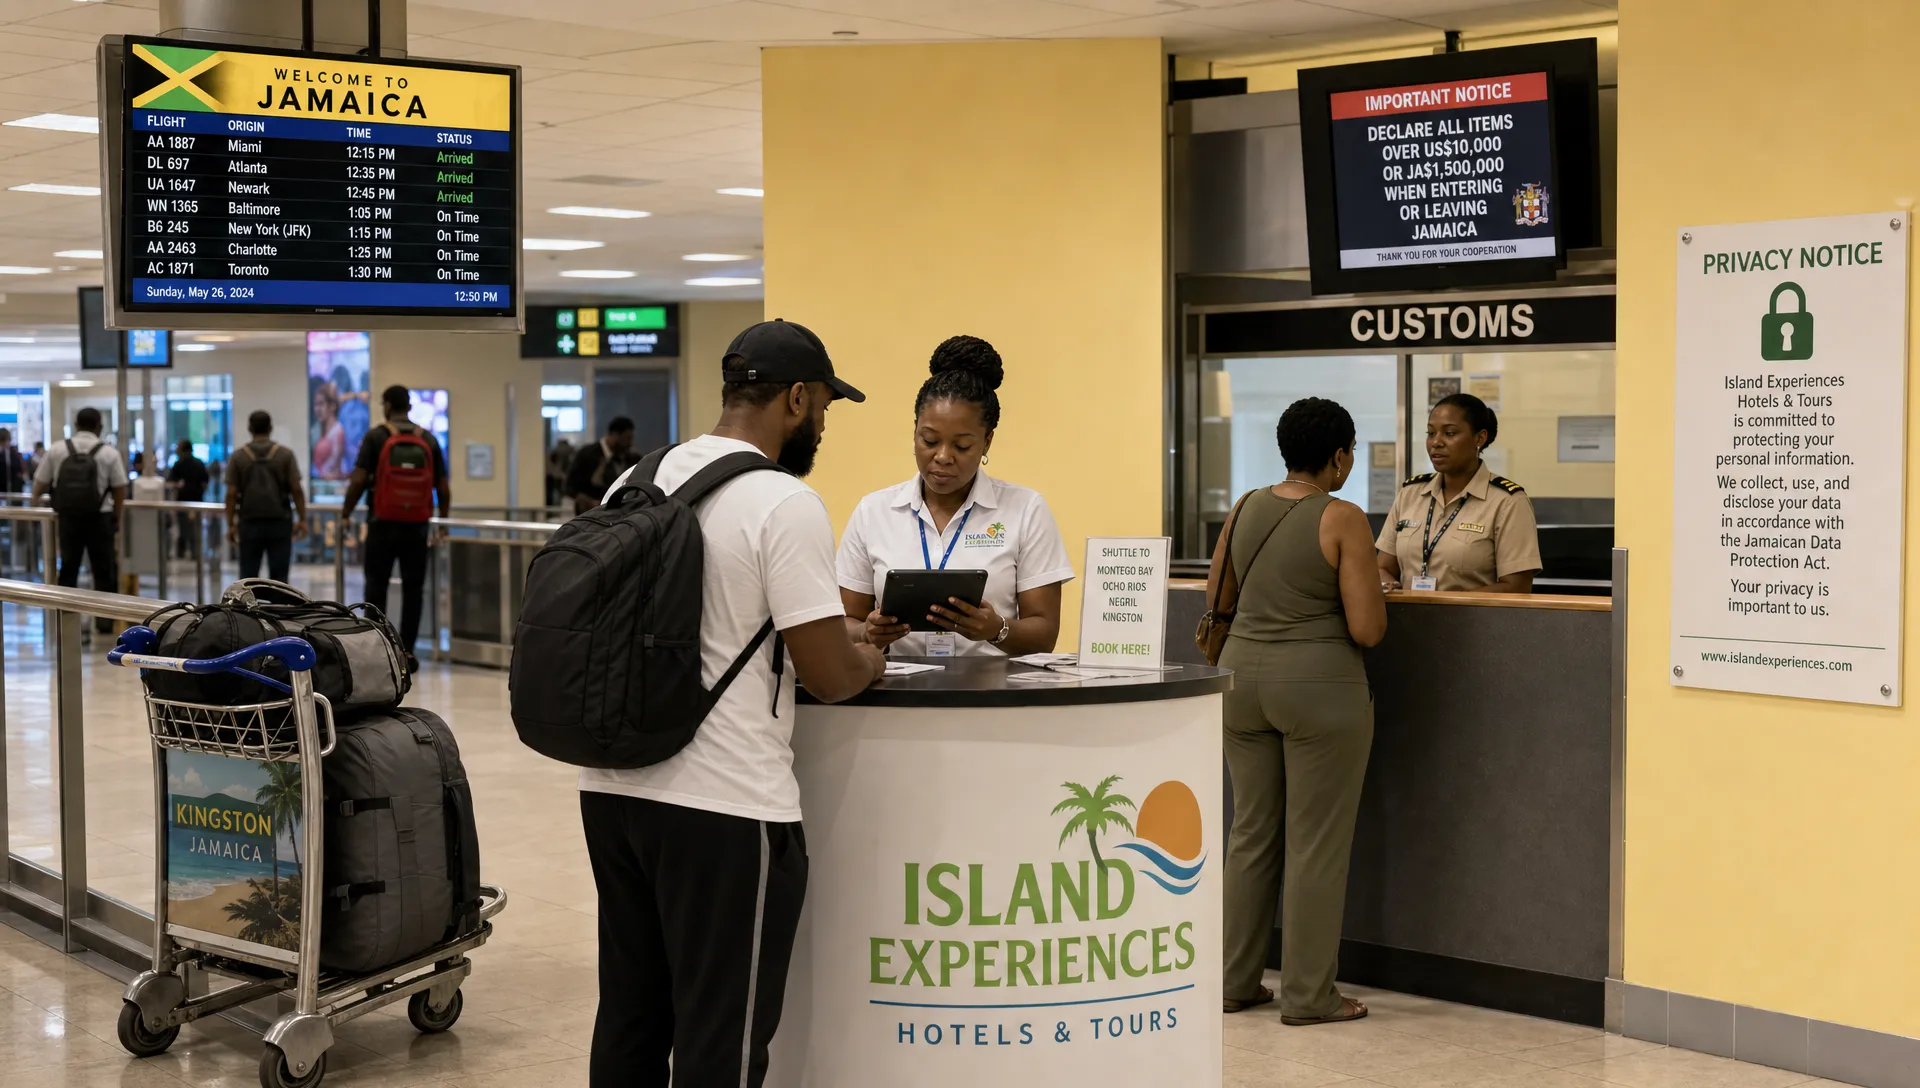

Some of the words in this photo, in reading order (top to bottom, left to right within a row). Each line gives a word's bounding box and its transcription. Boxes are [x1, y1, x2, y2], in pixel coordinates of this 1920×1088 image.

[274, 68, 373, 86] WELCOME
[385, 77, 408, 89] TO
[257, 85, 427, 118] JAMAICA
[1366, 88, 1450, 111] IMPORTANT
[1456, 82, 1511, 102] NOTICE
[148, 115, 186, 127] FLIGHT
[228, 120, 264, 132] ORIGIN
[347, 127, 371, 138] TIME
[437, 133, 472, 144] STATUS
[1367, 122, 1433, 142] DECLARE
[1438, 119, 1464, 135] ALL
[1469, 114, 1513, 132] ITEMS
[147, 135, 164, 148] AA
[169, 136, 195, 149] 1887
[229, 139, 261, 152] Miami
[347, 146, 374, 159] 12:15
[379, 148, 395, 160] PM
[437, 151, 473, 164] Arrived
[1383, 144, 1420, 161] OVER
[1425, 136, 1501, 157] US$10,000
[148, 156, 163, 169] DL
[168, 157, 189, 170] 697
[228, 160, 267, 173] Atlanta
[347, 166, 375, 179] 12:35
[379, 168, 395, 180] PM
[437, 171, 473, 184] Arrived
[1383, 166, 1403, 181] OR
[1407, 156, 1505, 181] JA$1,500,000
[148, 178, 164, 190] UA
[169, 179, 195, 191] 1647
[229, 181, 269, 194] Newark
[347, 186, 375, 199] 12:45
[379, 188, 394, 200] PM
[437, 190, 473, 203] Arrived
[1384, 184, 1426, 201] WHEN
[1431, 178, 1503, 197] ENTERING
[147, 199, 167, 212] WN
[171, 200, 198, 213] 1365
[229, 202, 280, 215] Baltimore
[349, 207, 371, 219] 1:05
[375, 208, 391, 219] PM
[437, 210, 451, 222] On
[455, 211, 479, 223] Time
[1400, 205, 1420, 220] OR
[1425, 200, 1487, 218] LEAVING
[148, 220, 163, 232] B6
[167, 221, 189, 233] 245
[229, 222, 252, 234] New
[256, 223, 279, 235] York
[283, 224, 310, 239] (JFK)
[349, 227, 370, 238] 1:15
[375, 227, 391, 239] PM
[437, 230, 451, 241] On
[454, 230, 479, 242] Time
[1412, 221, 1477, 240] JAMAICA
[147, 241, 164, 253] AA
[168, 242, 196, 254] 2463
[228, 243, 277, 256] Charlotte
[348, 246, 370, 258] 1:25
[375, 247, 391, 258] PM
[437, 249, 451, 260] On
[455, 250, 479, 261] Time
[1377, 252, 1402, 261] THANK
[1404, 251, 1420, 259] YOU
[1423, 250, 1437, 258] FOR
[1439, 249, 1460, 257] YOUR
[1463, 245, 1516, 256] COOPERATION
[1704, 249, 1793, 274] PRIVACY
[1801, 242, 1882, 268] NOTICE
[147, 262, 163, 274] AC
[168, 262, 193, 274] 1871
[228, 263, 269, 275] Toronto
[349, 266, 370, 278] 1:30
[375, 267, 391, 278] PM
[437, 268, 451, 280] On
[455, 269, 479, 280] Time
[147, 286, 185, 299] Sunday,
[189, 287, 208, 299] May
[212, 287, 226, 299] 26,
[230, 288, 254, 297] 2024
[455, 291, 480, 301] 12:50
[483, 292, 497, 301] PM
[1351, 304, 1534, 341] CUSTOMS
[1725, 375, 1762, 389] Island
[1768, 374, 1844, 391] Experiences
[1738, 394, 1778, 408] Hotels
[1784, 394, 1793, 407] &
[1797, 394, 1832, 407] Tours
[1735, 414, 1743, 427] is
[1748, 412, 1816, 427] committed
[1822, 414, 1835, 426] to
[1734, 432, 1799, 449] protecting
[1805, 435, 1834, 449] your
[1717, 451, 1769, 469] personal
[1775, 451, 1853, 465] information.
[1717, 475, 1736, 489] We
[1741, 475, 1787, 491] collect,
[1793, 479, 1818, 491] use,
[1824, 475, 1849, 489] and
[1723, 494, 1774, 508] disclose
[1779, 499, 1807, 512] your
[1812, 495, 1840, 509] data
[1722, 514, 1732, 527] in
[1737, 514, 1810, 529] accordance
[1815, 515, 1843, 529] with
[1721, 533, 1740, 547] the
[1745, 534, 1805, 548] Jamaican
[1811, 535, 1841, 549] Data
[1102, 548, 1137, 557] SHUTTLE
[1140, 548, 1150, 557] TO
[1731, 553, 1798, 568] Protection
[1804, 555, 1829, 569] Act.
[1097, 566, 1136, 575] MONTEGO
[1139, 566, 1153, 575] BAY
[1103, 582, 1125, 591] OCHO
[1128, 582, 1146, 591] RIOS
[1731, 579, 1761, 593] Your
[1766, 581, 1813, 599] privacy
[1819, 582, 1829, 596] is
[1109, 597, 1137, 607] NEGRIL
[1729, 598, 1790, 615] important
[1794, 602, 1806, 615] to
[1811, 606, 1829, 616] us.
[1103, 613, 1142, 622] KINGSTON
[1091, 643, 1118, 654] BOOK
[1122, 644, 1150, 655] HERE!
[1701, 652, 1852, 671] www.islandexperiences.com
[177, 803, 271, 836] KINGSTON
[190, 837, 262, 865] JAMAICA
[904, 858, 1135, 926] ISLAND
[869, 921, 1195, 987] EXPERIENCES
[899, 1022, 1032, 1045] HOTELS
[1055, 1021, 1070, 1042] &
[1090, 1008, 1176, 1039] TOURS
